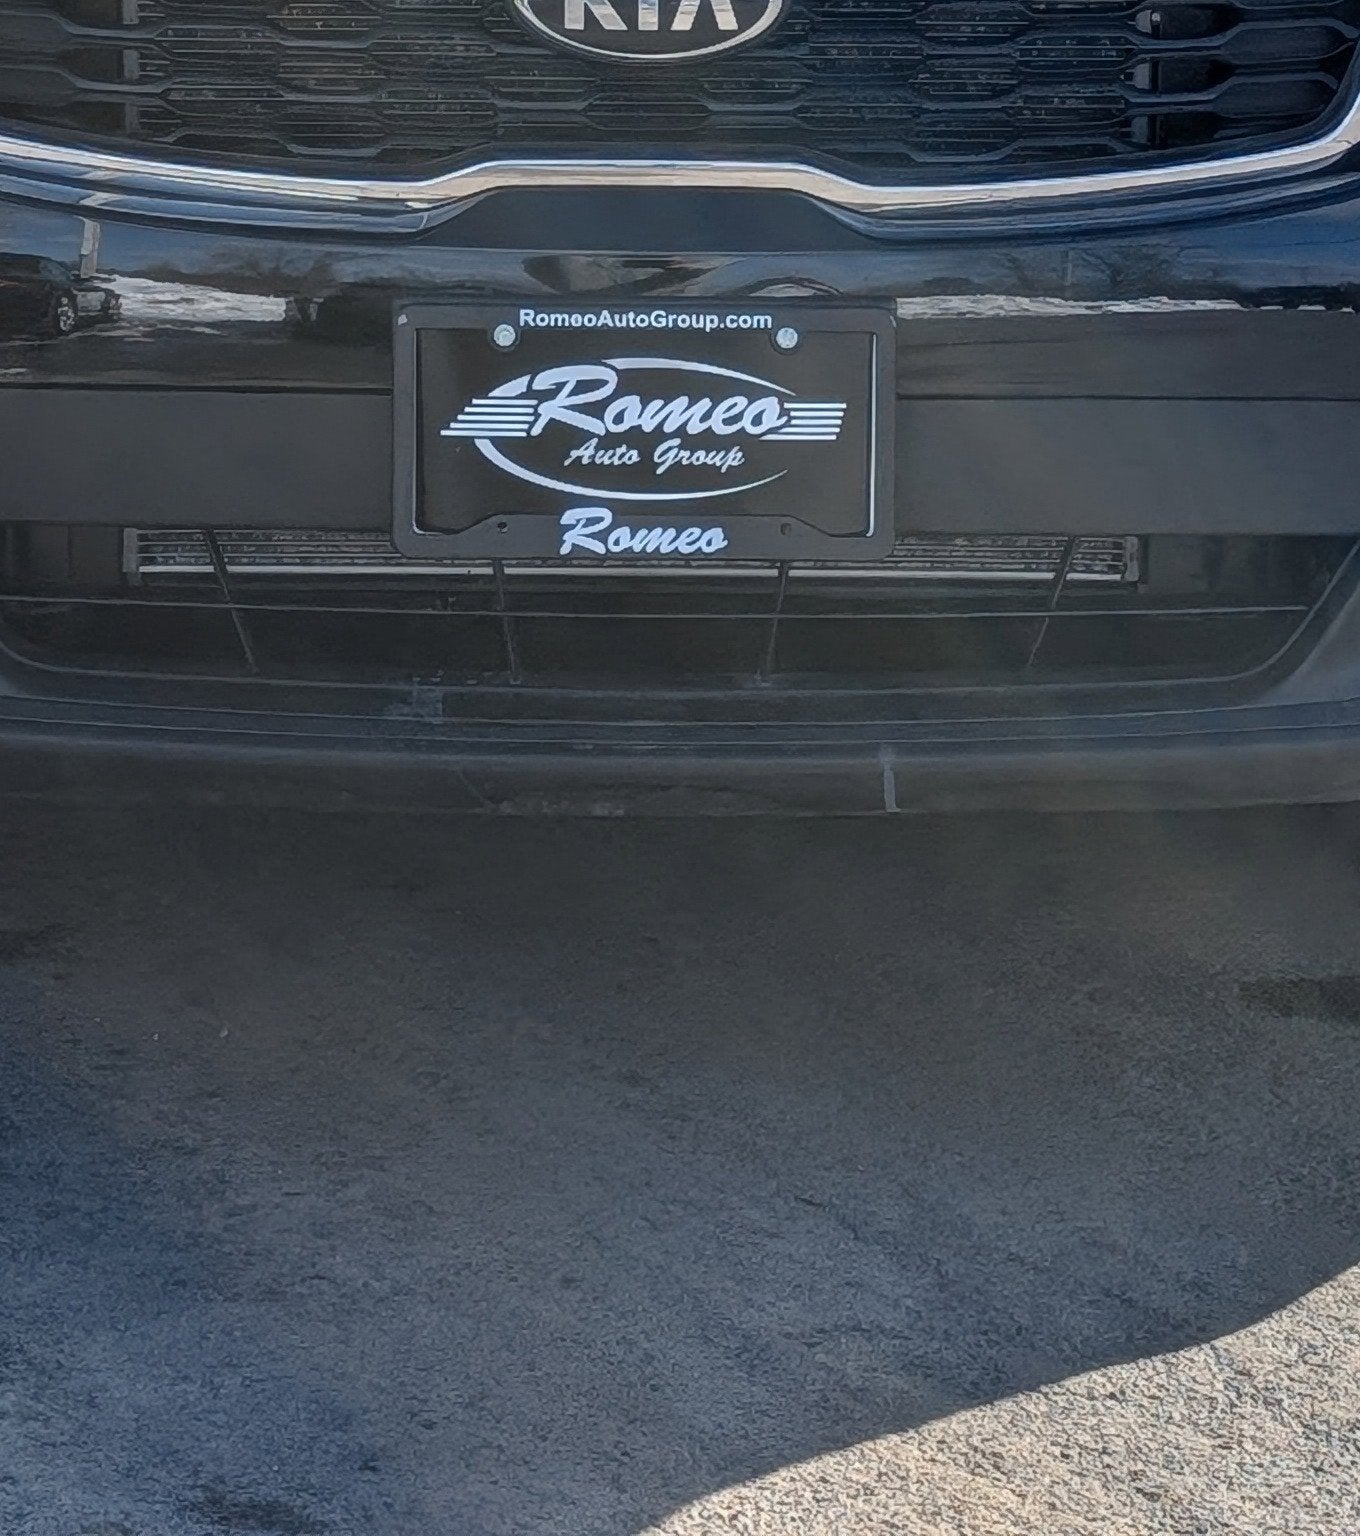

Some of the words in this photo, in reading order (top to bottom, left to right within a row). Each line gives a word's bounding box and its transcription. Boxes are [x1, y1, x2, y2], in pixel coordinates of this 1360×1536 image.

[518, 309, 773, 332] RomeoAutoGroup.com
[529, 364, 788, 437] Romeo
[564, 437, 640, 467] Auto
[653, 438, 746, 474] Group
[559, 507, 729, 555] Romeo
